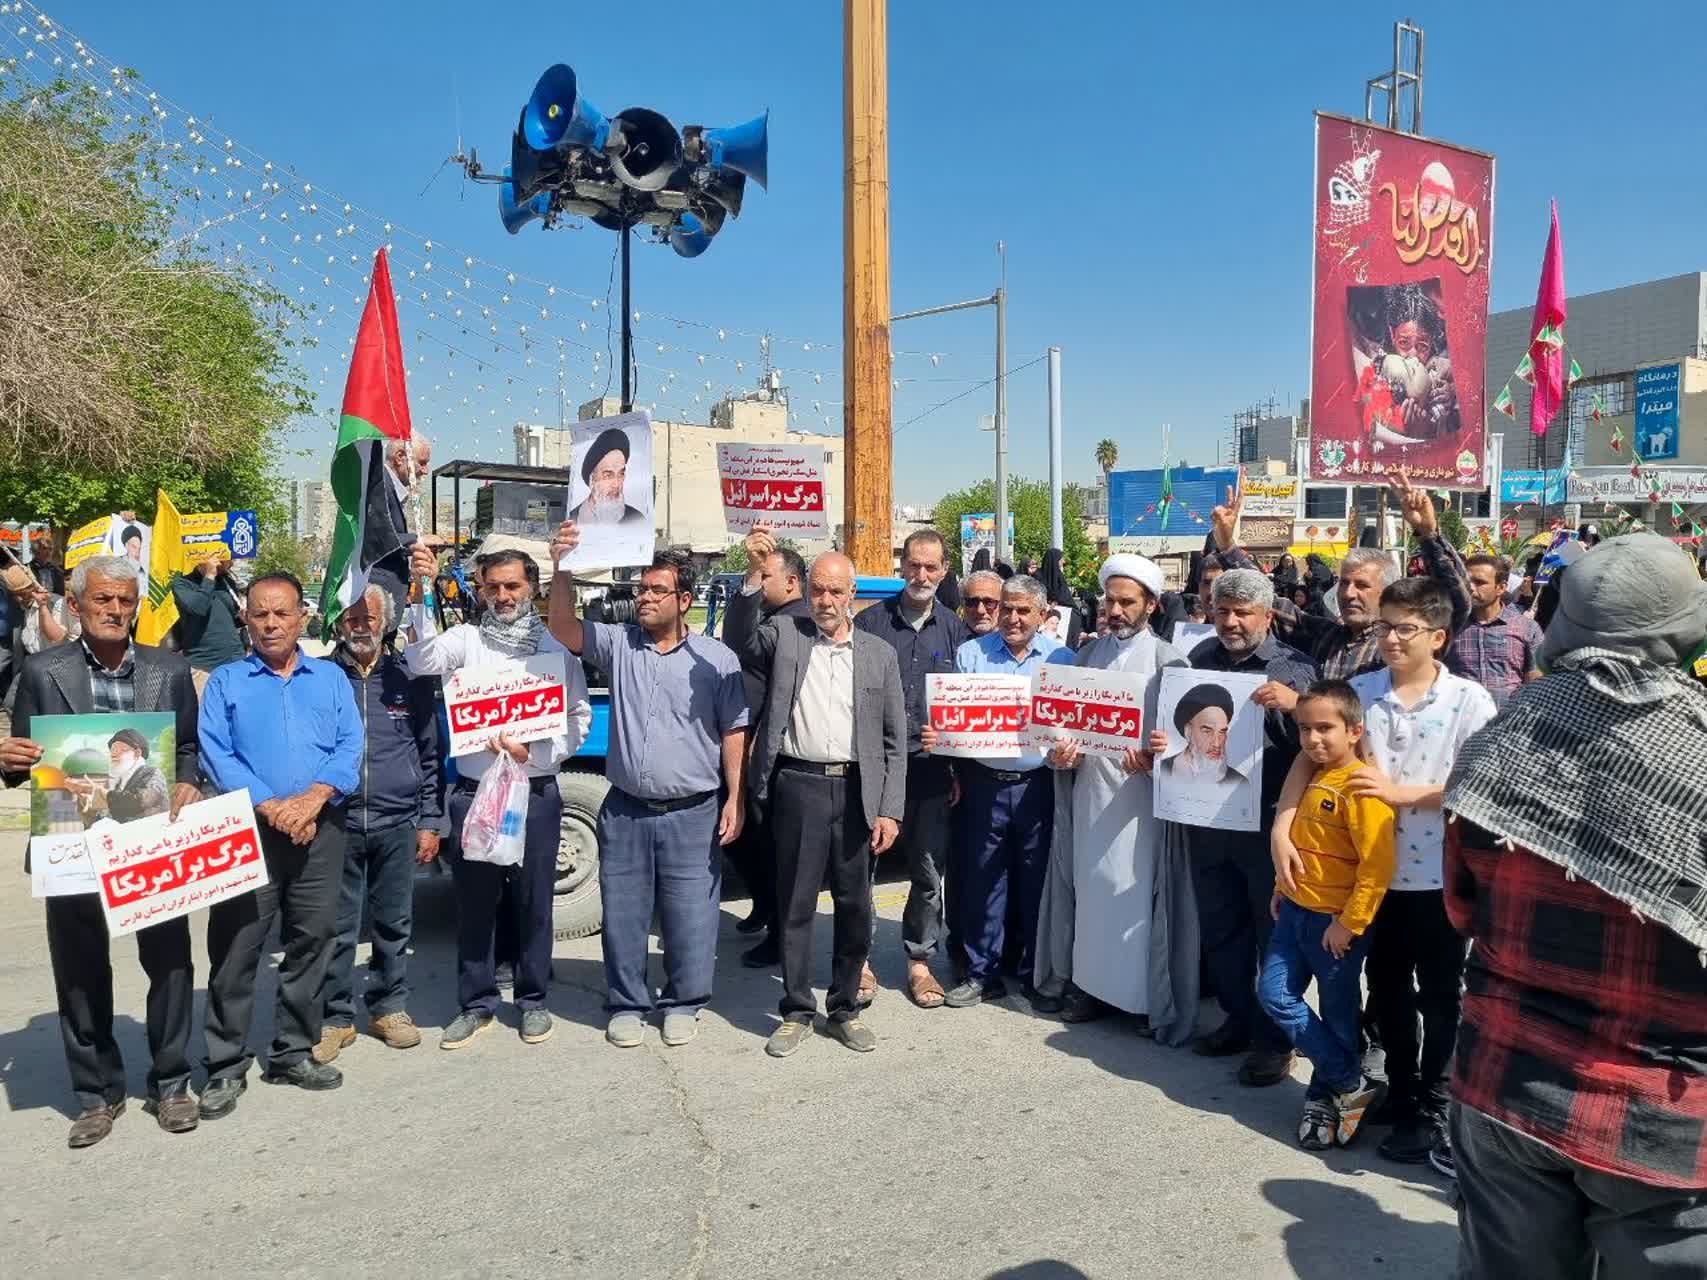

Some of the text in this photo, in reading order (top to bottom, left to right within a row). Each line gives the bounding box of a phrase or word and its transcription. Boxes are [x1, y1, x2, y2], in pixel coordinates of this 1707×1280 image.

[1395, 194, 1480, 275] القدس
[1638, 371, 1678, 384] درمانگاه
[1641, 400, 1673, 415] میترا
[726, 480, 818, 510] مرگ بر اسرائیل
[522, 674, 547, 686] آمریکا
[547, 672, 556, 681] ما
[455, 687, 480, 699] گذاریم
[1039, 682, 1062, 694] گذاریم
[1102, 689, 1124, 702] آمریکا
[454, 693, 560, 728] مرگ بر آمریکا
[934, 706, 991, 731] اسرائیل
[987, 712, 1003, 731] بر
[1035, 700, 1136, 736] مرگ بر آمریکا
[201, 817, 231, 836] آمریکا
[231, 815, 242, 825] ما
[174, 835, 190, 847] زیر
[189, 829, 201, 841] را
[146, 843, 164, 855] می
[109, 847, 143, 866] گذاریم
[109, 840, 253, 898] مرگ بر آمریکا
[203, 887, 219, 898] امور
[142, 904, 165, 917] استان
[119, 913, 142, 927] فارس
